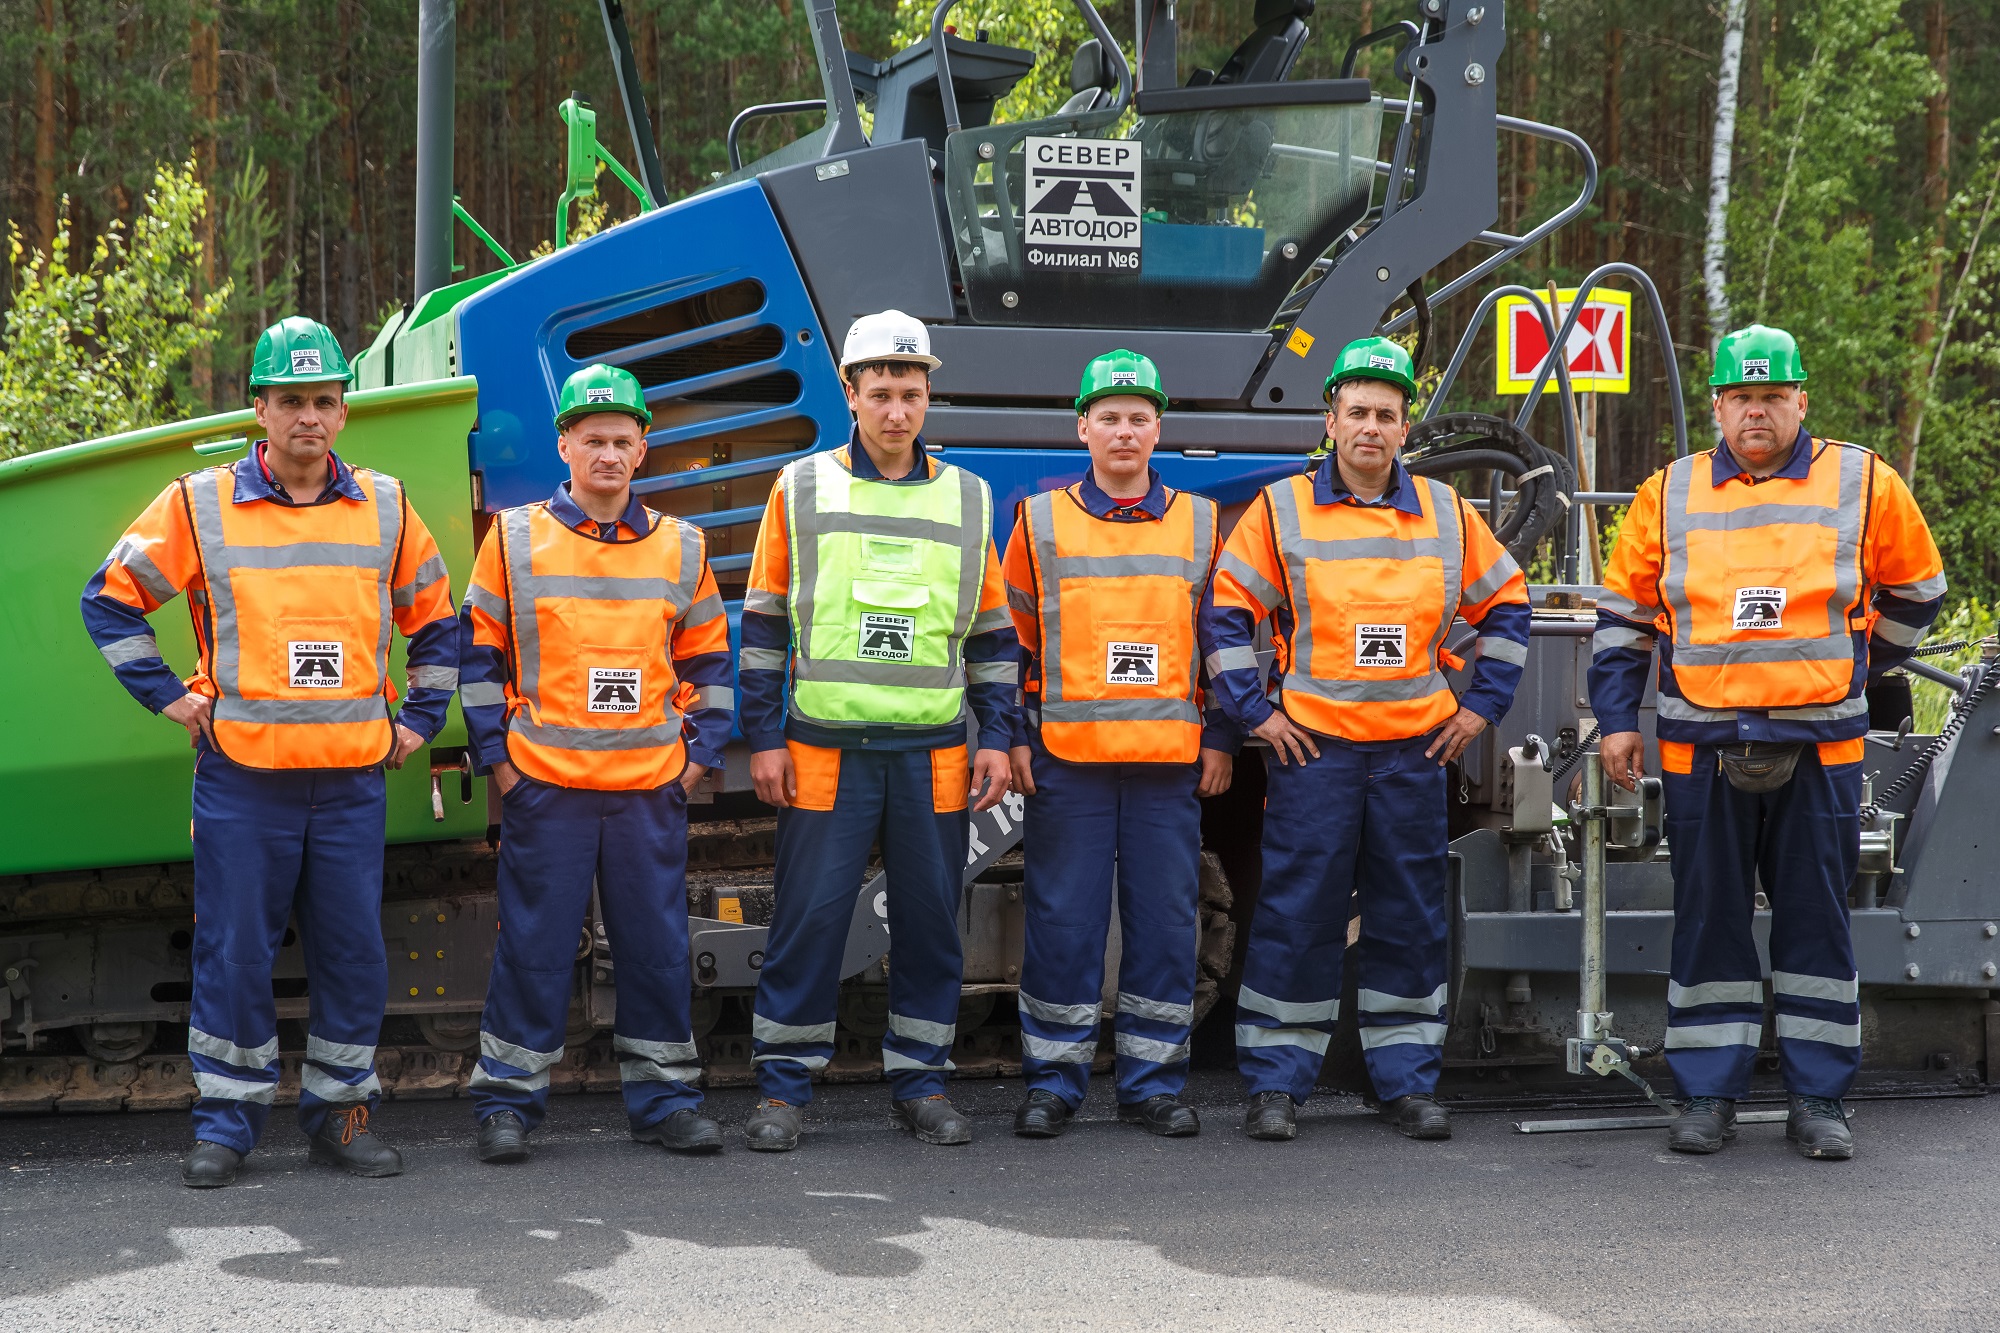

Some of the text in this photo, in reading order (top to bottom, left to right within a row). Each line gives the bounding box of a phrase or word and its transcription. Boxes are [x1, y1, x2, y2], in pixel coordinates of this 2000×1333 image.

[1037, 144, 1130, 166] СЕВЕР
[1029, 218, 1138, 241] АВТОДОР
[1027, 248, 1139, 269] Филиал №6
[1372, 355, 1393, 364] СЕВЕР
[1740, 589, 1781, 597] СЕВЕР
[866, 615, 909, 625] СЕВЕР
[1735, 619, 1779, 629] АВТОДОР
[295, 643, 339, 651] СЕВЕР
[1113, 643, 1154, 652] СЕВЕР
[861, 648, 909, 659] АВТОДОР
[1358, 657, 1403, 666] АВТОДОР
[594, 670, 637, 678] СЕВЕР
[293, 677, 340, 686] АВТОДОР
[1110, 675, 1155, 684] АВТОДОР
[591, 703, 637, 712] АВТОДОР
